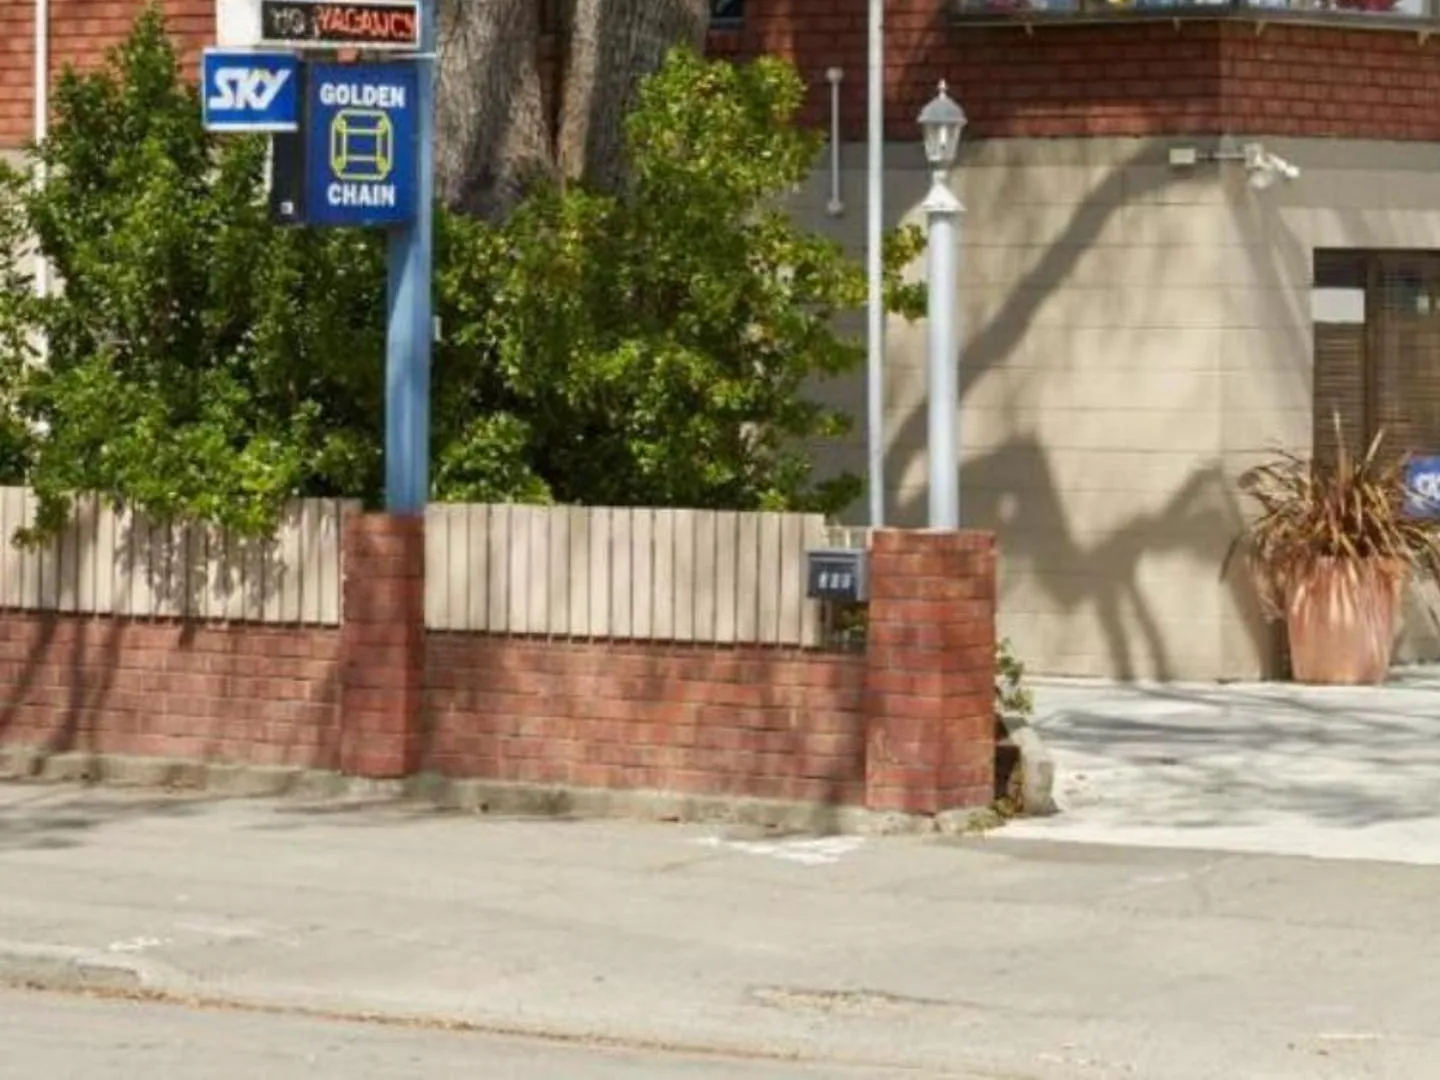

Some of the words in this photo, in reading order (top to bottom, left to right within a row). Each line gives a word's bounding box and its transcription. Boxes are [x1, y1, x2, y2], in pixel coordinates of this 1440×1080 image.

[316, 5, 415, 39] VACANCY
[208, 66, 291, 110] SKY
[319, 82, 406, 108] GOLDEN
[327, 183, 396, 207] CHAIN
